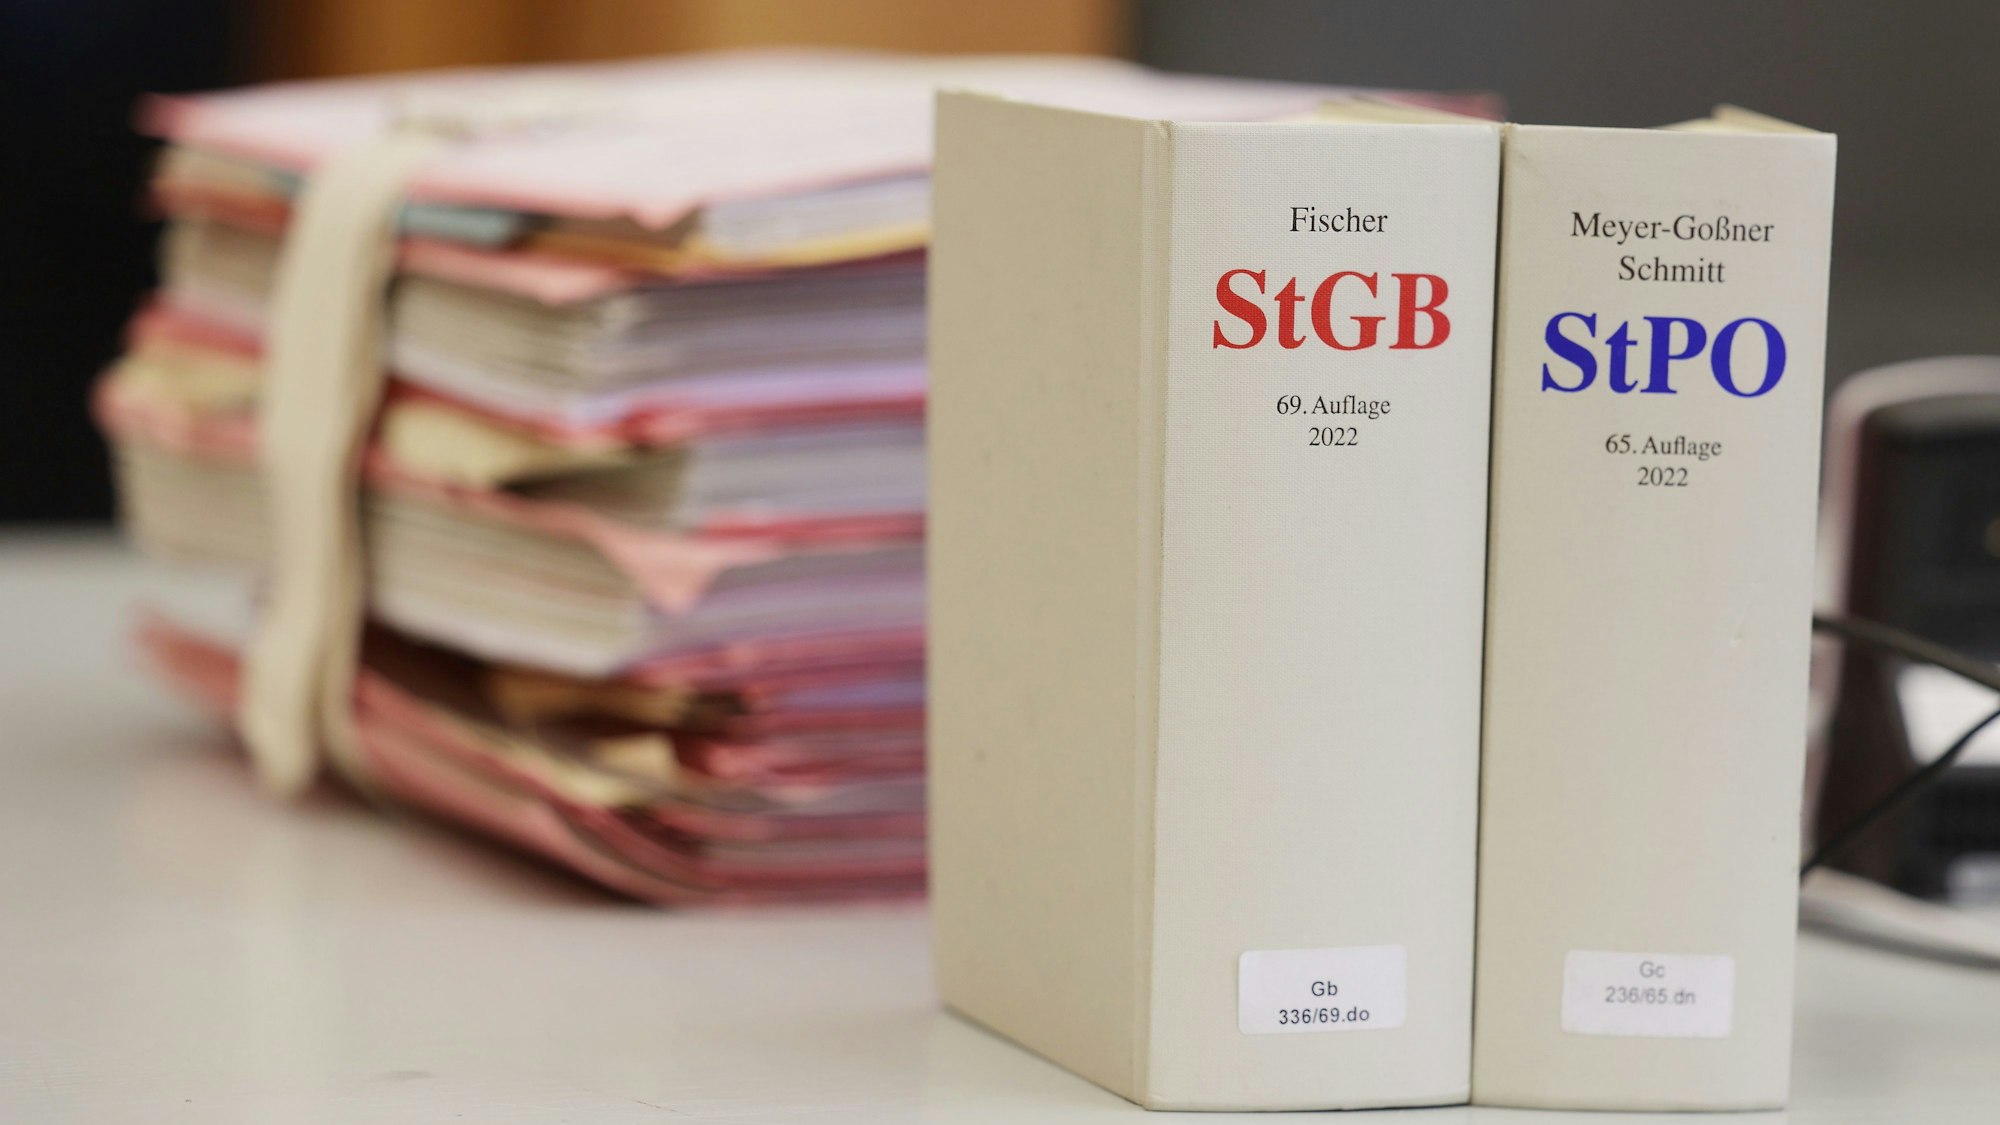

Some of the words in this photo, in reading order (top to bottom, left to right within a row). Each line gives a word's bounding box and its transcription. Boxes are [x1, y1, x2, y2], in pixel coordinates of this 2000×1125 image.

[1289, 206, 1389, 233] Fischer
[1570, 211, 1775, 246] Meyer-Goßner
[1617, 255, 1725, 283] Schmitt
[1212, 268, 1452, 351] StGB
[1541, 311, 1788, 398] StPO
[1276, 394, 1308, 416] 69.
[1310, 394, 1391, 420] Auflage
[1308, 427, 1359, 447] 2022
[1605, 433, 1638, 455] 65.
[1641, 434, 1723, 461] Auflage
[1637, 466, 1689, 487] 2022
[1638, 959, 1667, 979] Gc
[1311, 979, 1339, 997] Gb
[1604, 985, 1696, 1006] 236/65.dn
[1278, 1005, 1371, 1025] 336/69.do
